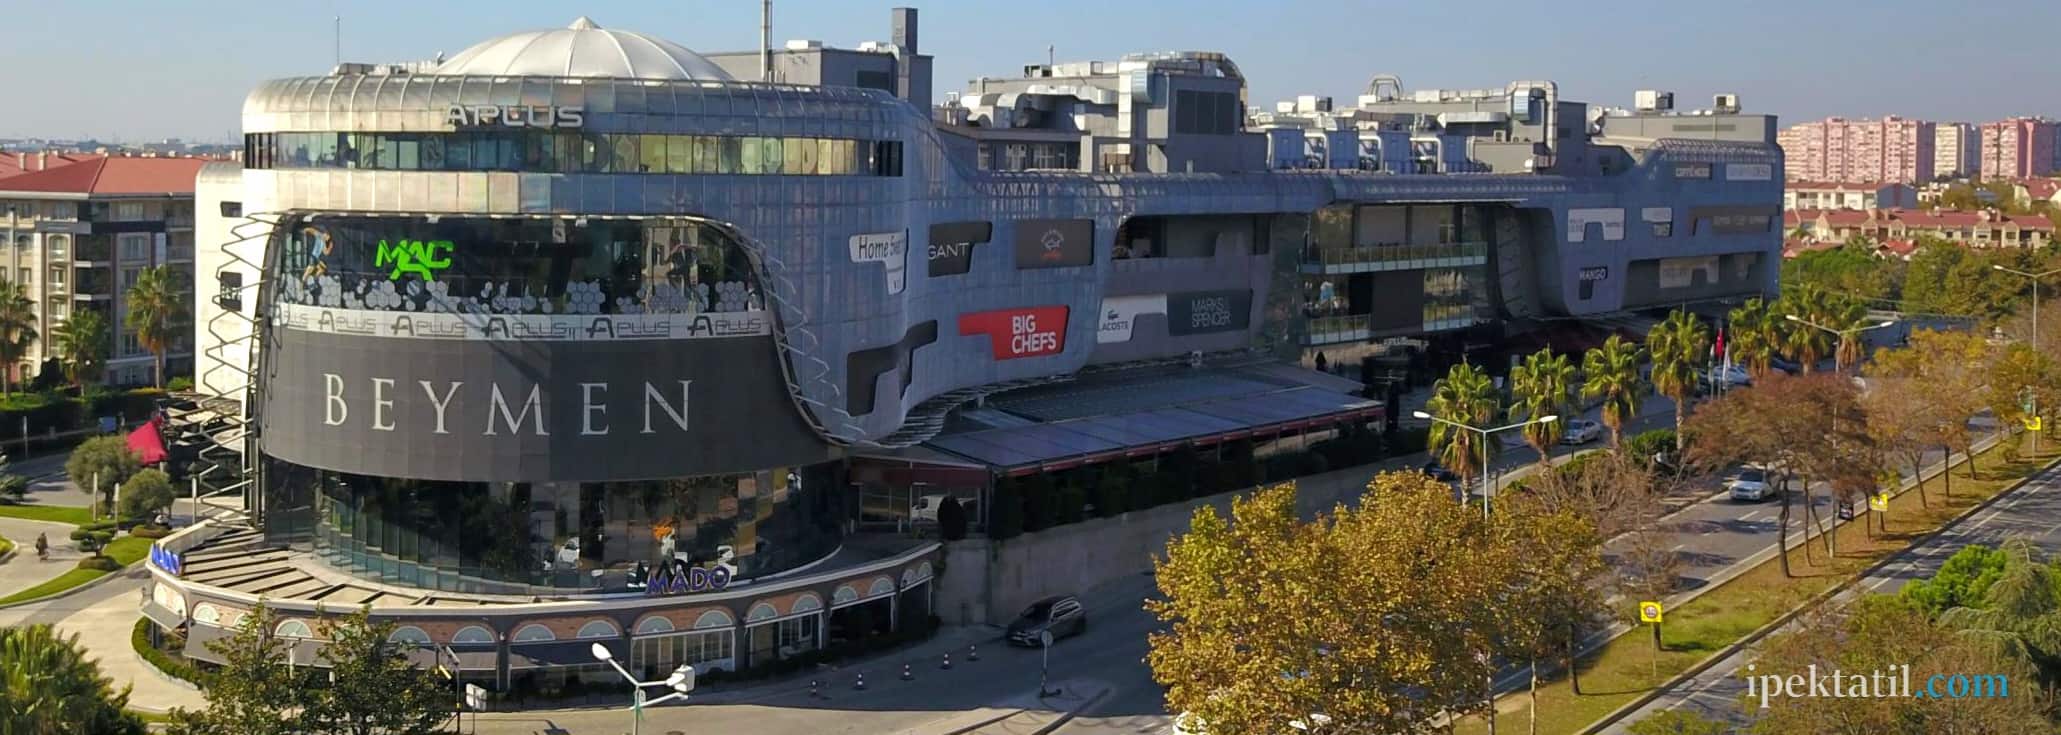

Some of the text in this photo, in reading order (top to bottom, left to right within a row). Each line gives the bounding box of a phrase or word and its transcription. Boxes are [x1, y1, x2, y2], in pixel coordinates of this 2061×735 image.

[448, 105, 583, 128] APLUS
[857, 235, 889, 261] Home
[928, 242, 970, 260] GANT
[375, 240, 455, 281] MAC
[1012, 315, 1036, 335] BIG
[1011, 331, 1057, 354] CHEFS
[322, 373, 693, 436] BEYMEN
[645, 564, 732, 595] MADO
